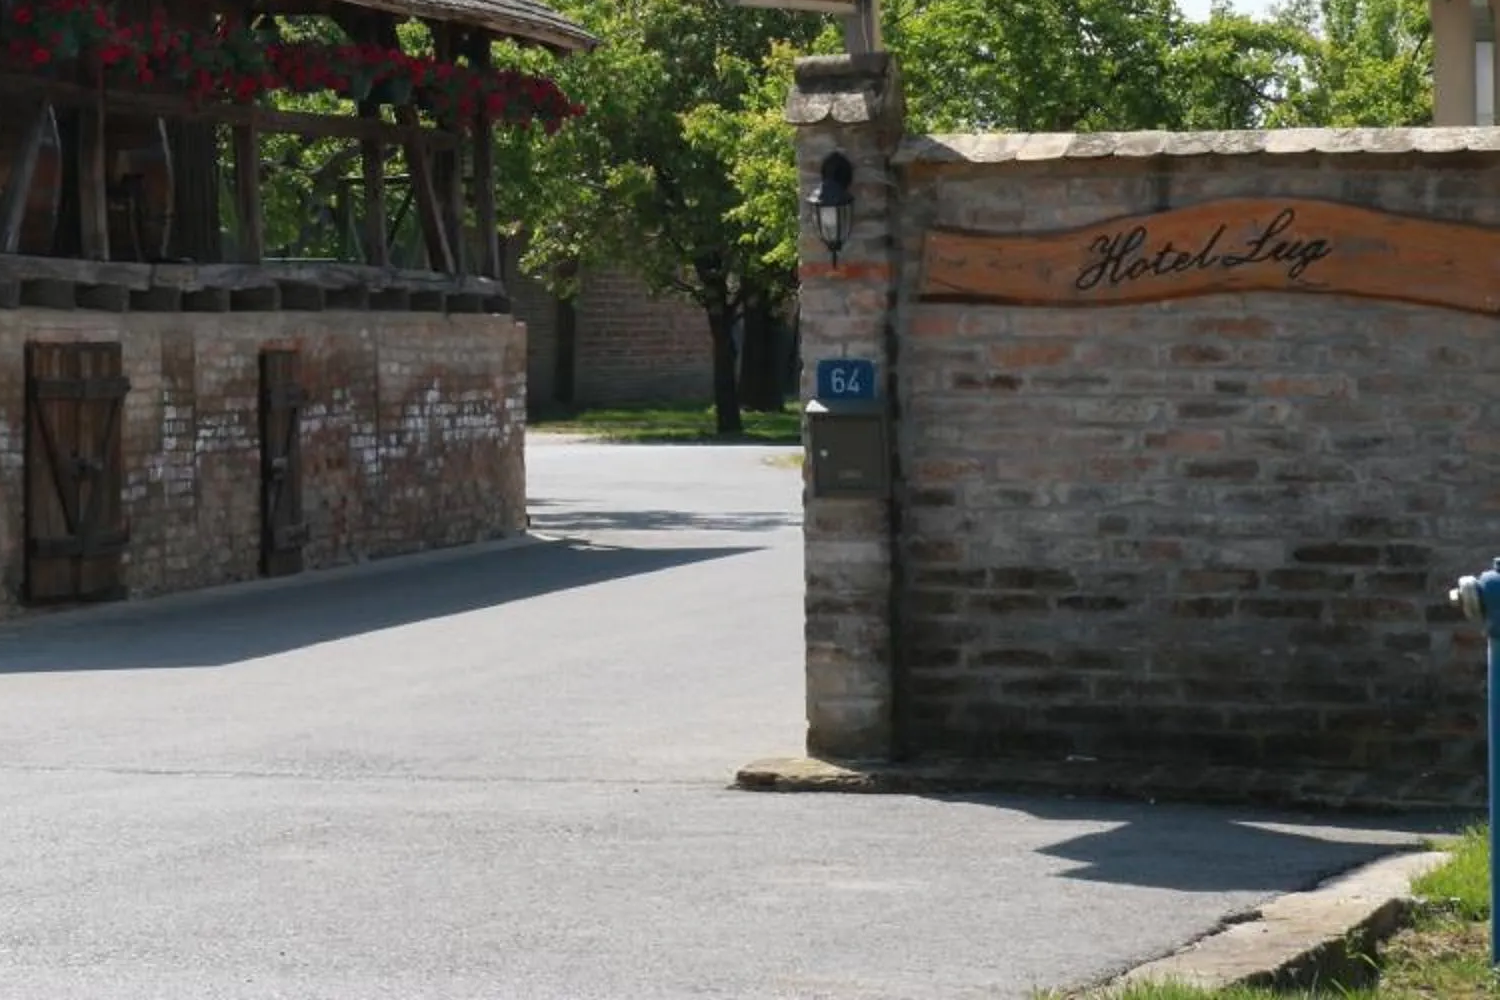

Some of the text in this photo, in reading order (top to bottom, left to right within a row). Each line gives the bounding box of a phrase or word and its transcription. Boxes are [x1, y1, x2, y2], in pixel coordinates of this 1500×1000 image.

[1075, 207, 1332, 290] Hotel Lug
[830, 367, 861, 394] 64
